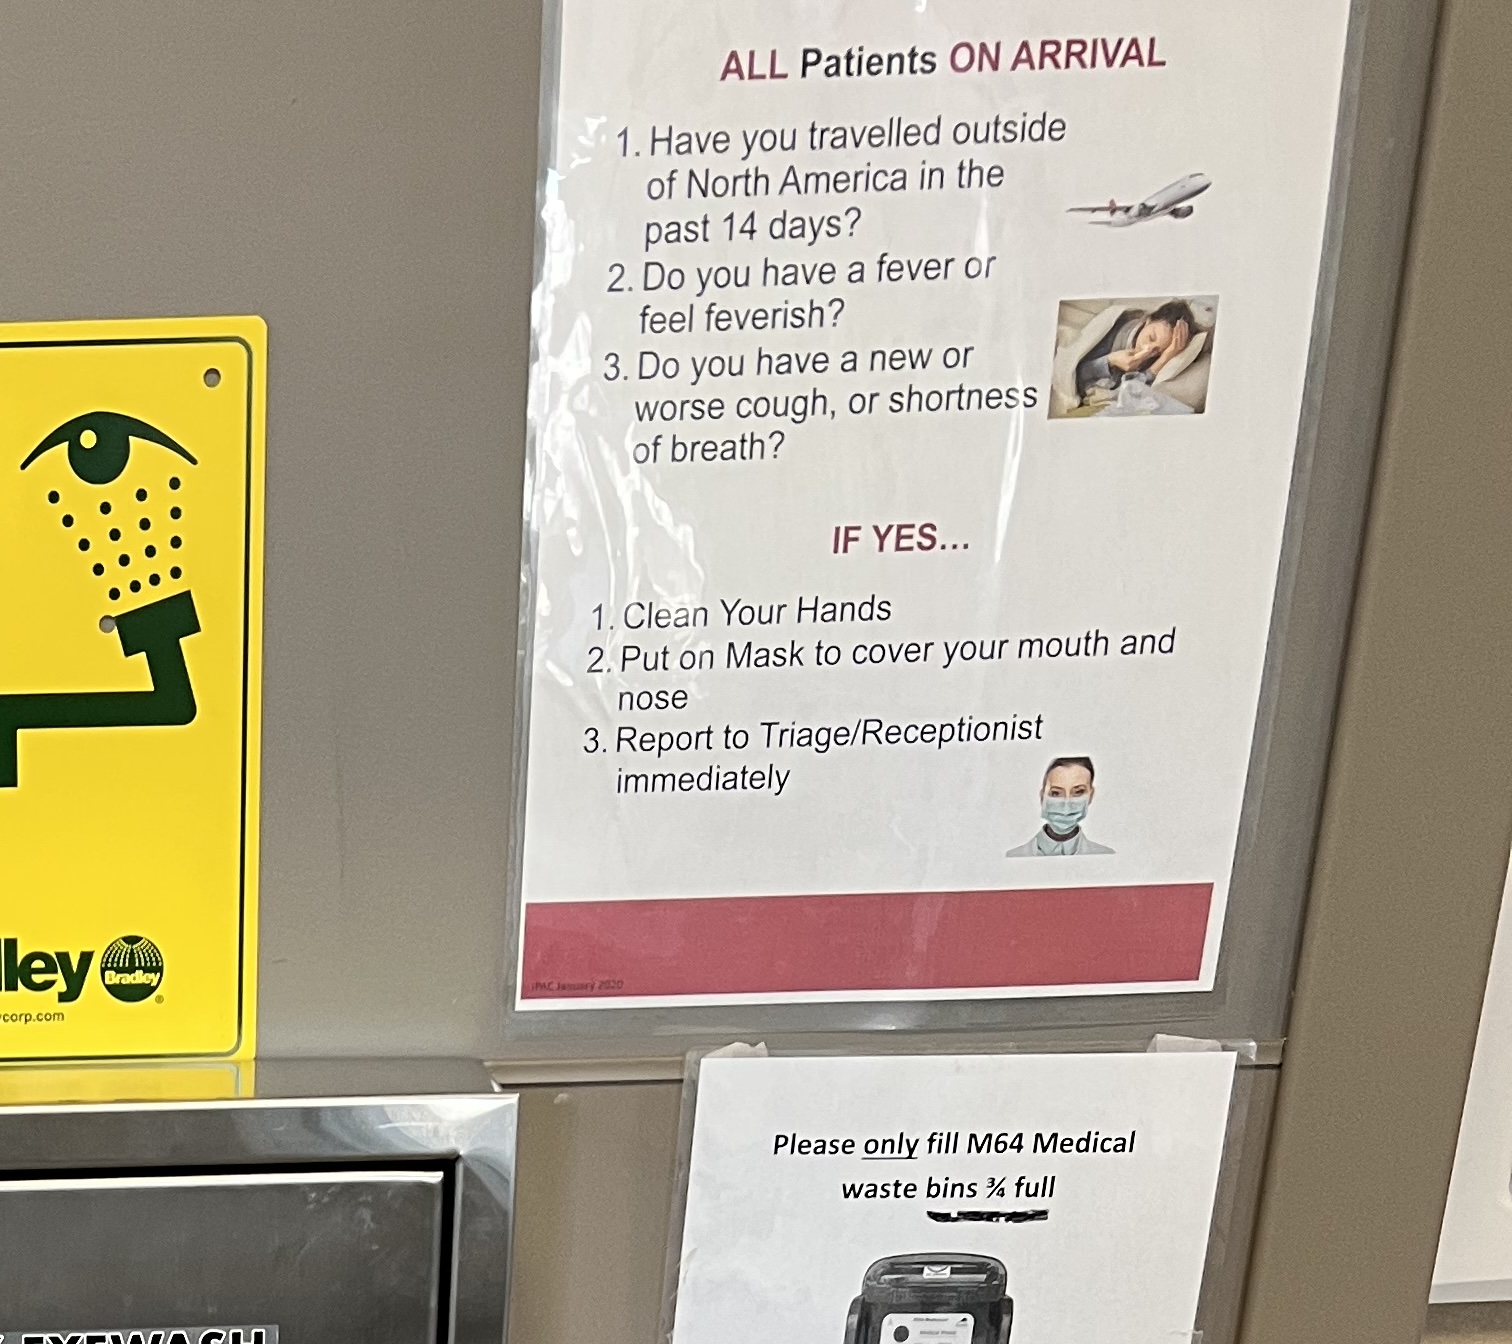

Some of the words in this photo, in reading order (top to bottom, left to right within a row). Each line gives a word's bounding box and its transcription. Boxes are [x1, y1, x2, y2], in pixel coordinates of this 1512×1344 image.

[719, 48, 789, 82] ALL
[800, 44, 937, 79] Patients
[949, 40, 1002, 74] ON
[1009, 36, 1167, 72] ARRIVAL
[616, 125, 641, 158] 1.
[650, 124, 731, 157] Have
[740, 127, 797, 162] you
[808, 114, 942, 152] travelled
[952, 110, 1067, 146] outside
[646, 168, 679, 202] of
[686, 164, 770, 200] North
[777, 160, 908, 197] America
[919, 158, 945, 191] in
[956, 157, 1005, 190] the
[644, 212, 711, 253] past
[722, 209, 758, 243] 14
[768, 205, 862, 248] days?
[606, 262, 634, 293] 2.
[642, 260, 686, 292] Do
[695, 264, 751, 298] you
[761, 256, 837, 288] have
[846, 260, 866, 284] a
[876, 251, 956, 283] fever
[964, 255, 997, 280] or
[638, 302, 695, 335] feel
[704, 297, 845, 333] feverish?
[602, 351, 629, 382] 3.
[637, 350, 680, 381] Do
[689, 353, 745, 387] you
[755, 345, 830, 377] have
[840, 350, 858, 374] a
[868, 347, 934, 373] new
[942, 345, 975, 370] or
[634, 397, 726, 423] worse
[735, 386, 836, 425] cough,
[848, 391, 881, 415] or
[888, 382, 1038, 414] shortness
[632, 433, 664, 465] of
[670, 429, 786, 463] breath?
[832, 525, 863, 555] IF
[591, 602, 615, 631] 1.
[623, 600, 709, 630] Clean
[719, 597, 788, 627] Your
[796, 593, 892, 625] Hands
[586, 645, 612, 674] 2.
[620, 644, 671, 673] Put
[679, 649, 715, 671] on
[726, 639, 806, 670] Mask
[814, 639, 842, 667] to
[851, 641, 935, 665] cover
[941, 638, 1010, 670] your
[1017, 628, 1110, 660] mouth
[1119, 625, 1177, 656] and
[618, 689, 689, 712] nose
[582, 726, 607, 754] 3.
[616, 724, 715, 760] Report
[722, 723, 750, 750] to
[759, 713, 1044, 754] Triage/Receptionist
[616, 762, 791, 797] immediately
[103, 969, 162, 988] Bradley
[772, 1132, 856, 1156] Please
[860, 1131, 921, 1161] only
[926, 1131, 960, 1155] fill
[966, 1132, 1025, 1156] M64
[1032, 1129, 1137, 1155] Medical
[841, 1179, 918, 1200] waste
[925, 1175, 979, 1199] bins
[1014, 1175, 1057, 1199] full
